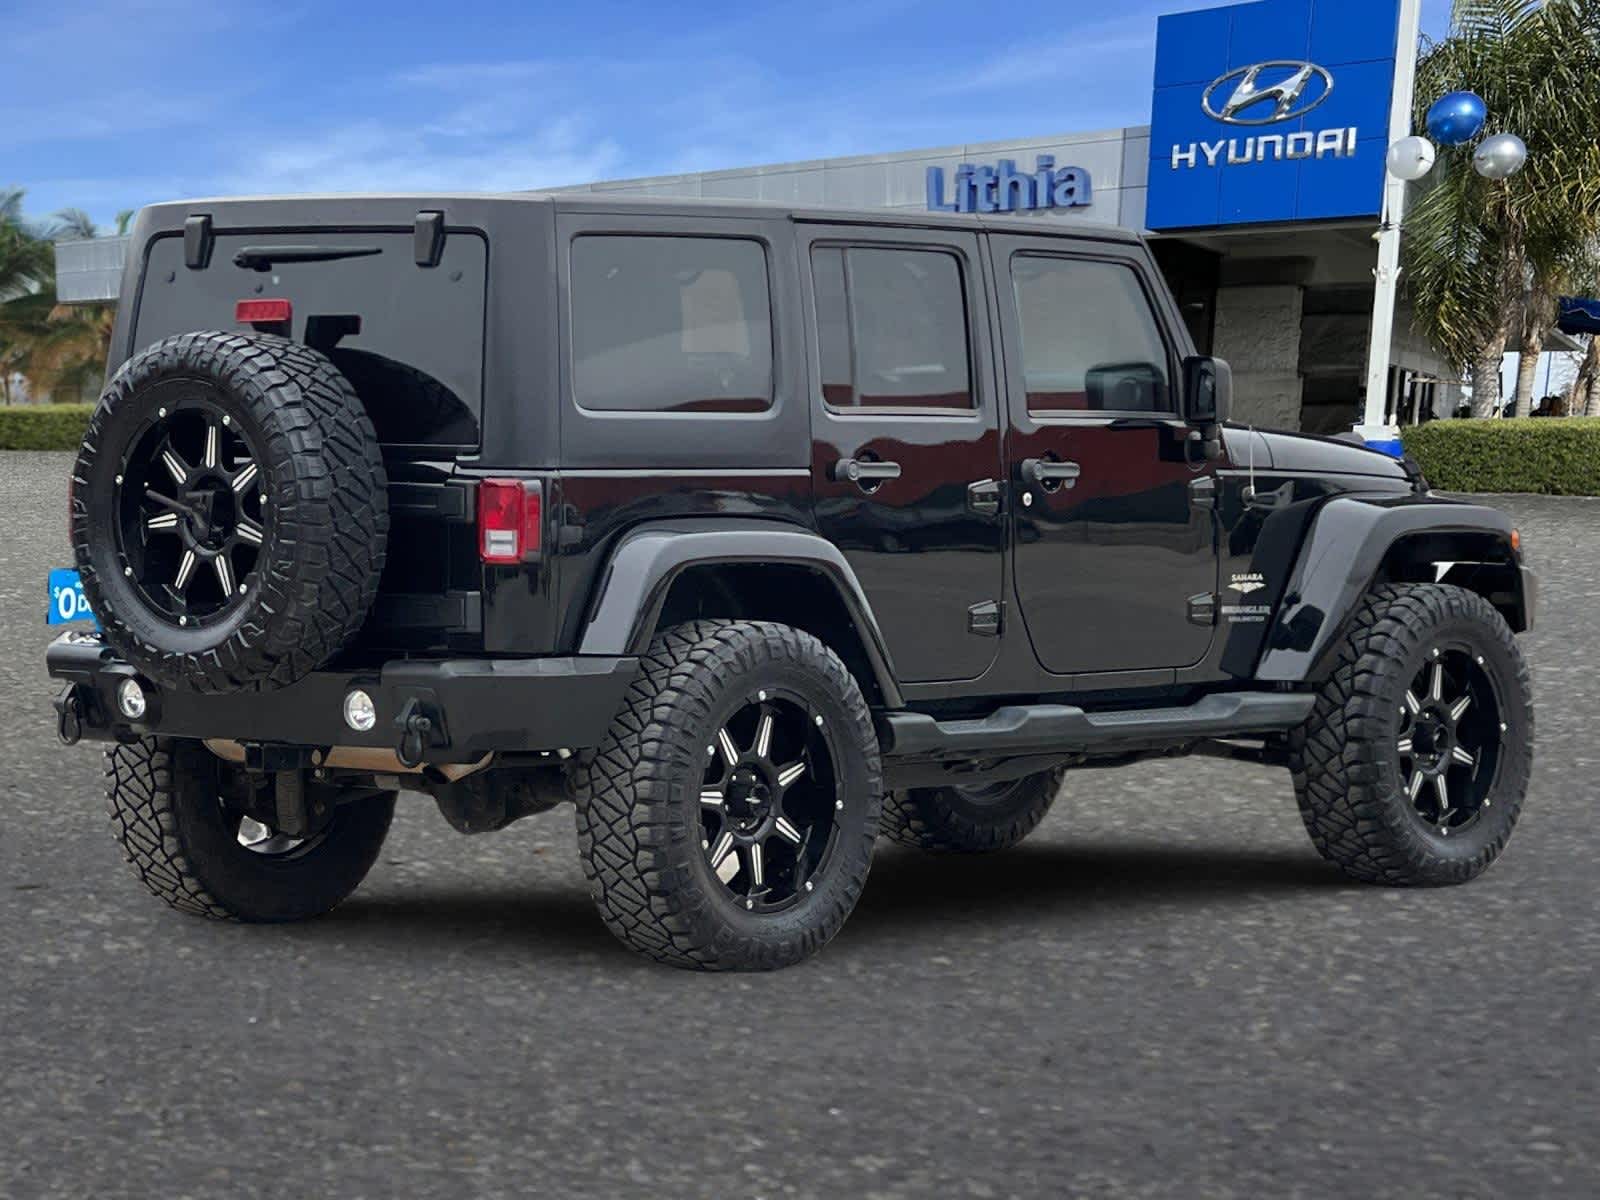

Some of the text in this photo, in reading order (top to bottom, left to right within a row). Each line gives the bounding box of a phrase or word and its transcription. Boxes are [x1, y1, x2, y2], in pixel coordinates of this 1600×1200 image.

[1171, 127, 1358, 169] HYUNDAI
[926, 154, 1093, 213] Lithia
[1231, 573, 1264, 582] SAHARA
